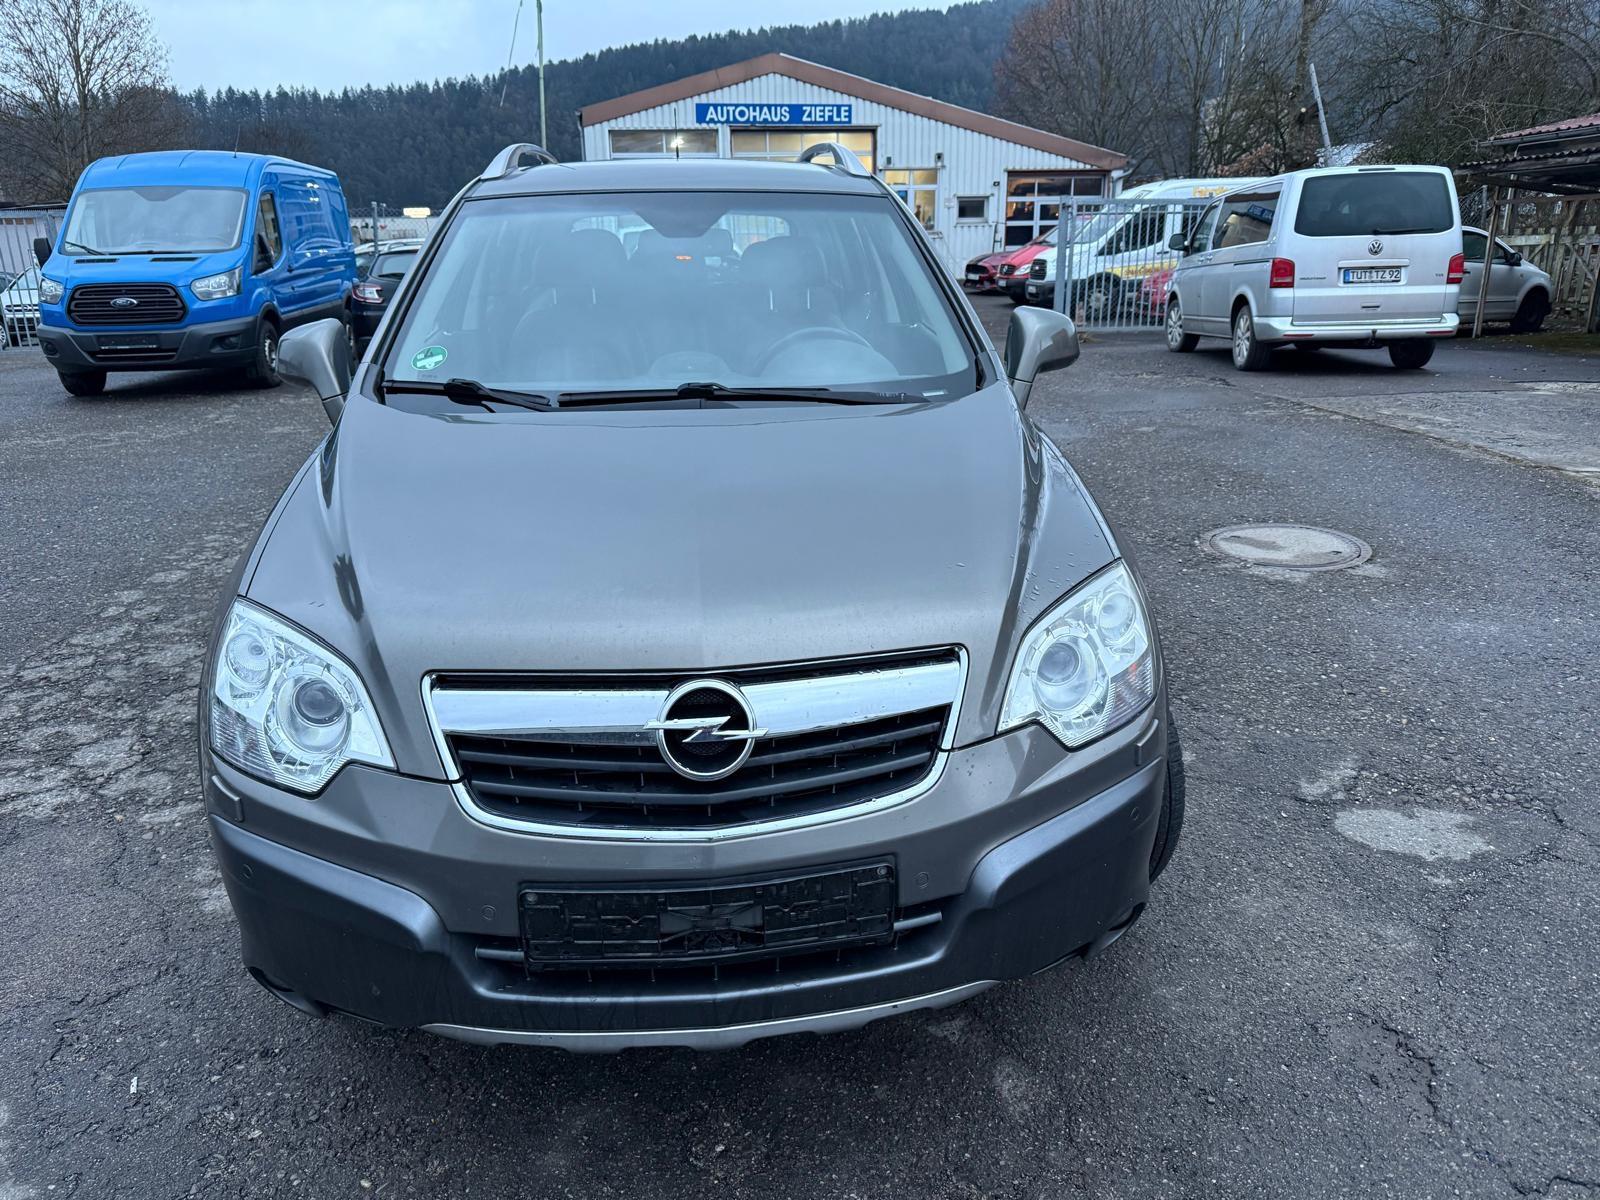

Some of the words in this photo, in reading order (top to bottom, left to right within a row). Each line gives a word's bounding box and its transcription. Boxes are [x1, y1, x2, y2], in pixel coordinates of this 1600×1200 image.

[705, 105, 790, 122] AUTOHAUS
[802, 106, 849, 122] ZIEFLE
[1351, 270, 1370, 280] TUT
[1375, 270, 1387, 279] TZ
[1388, 269, 1400, 279] 92
